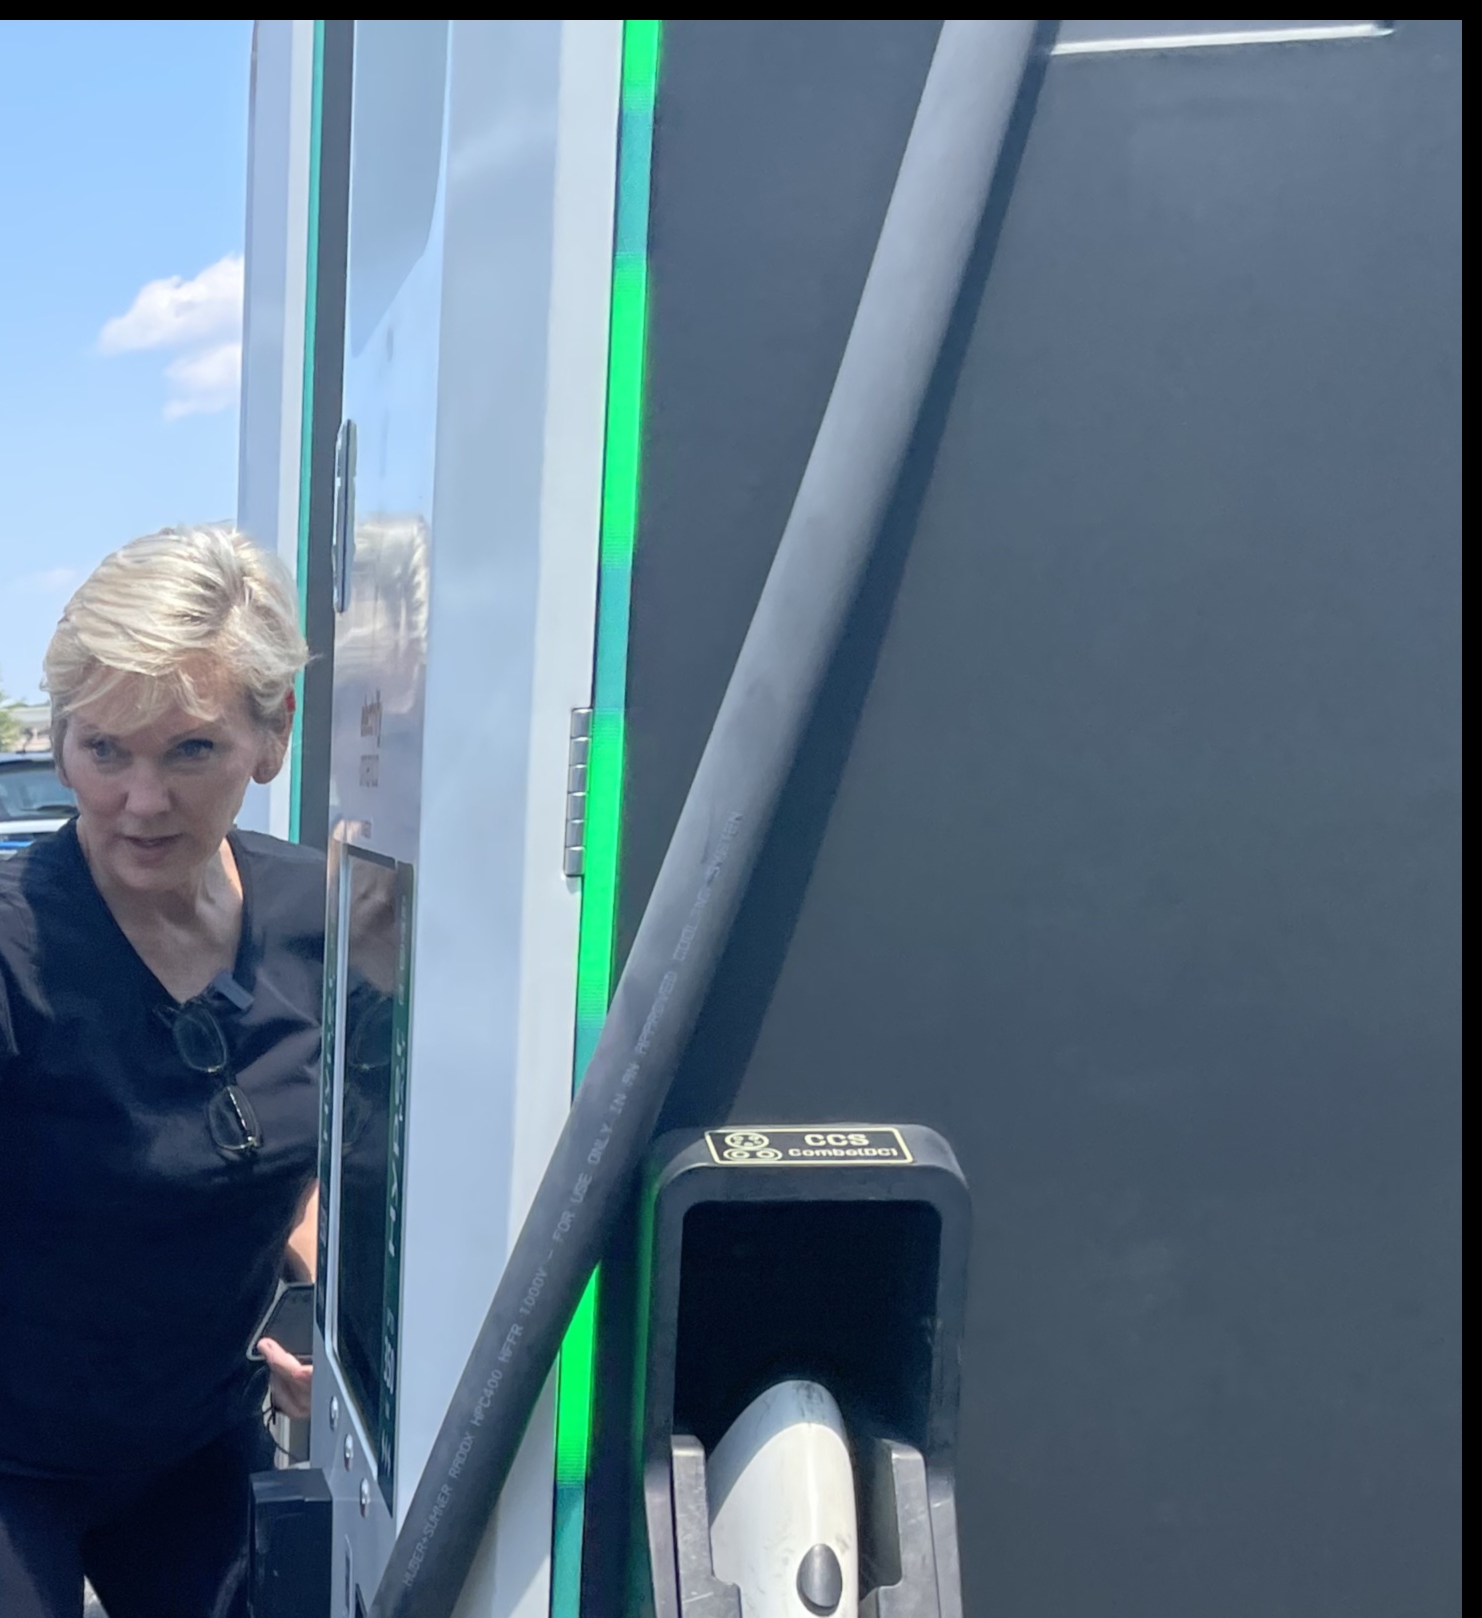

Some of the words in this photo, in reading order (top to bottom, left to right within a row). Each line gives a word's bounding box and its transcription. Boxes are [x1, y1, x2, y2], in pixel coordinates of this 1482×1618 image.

[804, 1133, 869, 1146] CCS
[401, 1482, 453, 1586] HUBER+SUHNER
[447, 1430, 476, 1478] RADOX
[469, 1368, 503, 1427] HPC400
[496, 1322, 524, 1364] HFFR
[551, 1209, 576, 1243] FOR
[569, 1171, 593, 1205] USE
[585, 1120, 614, 1166] ONLY
[608, 1091, 627, 1115] IN
[620, 1061, 640, 1087] AN
